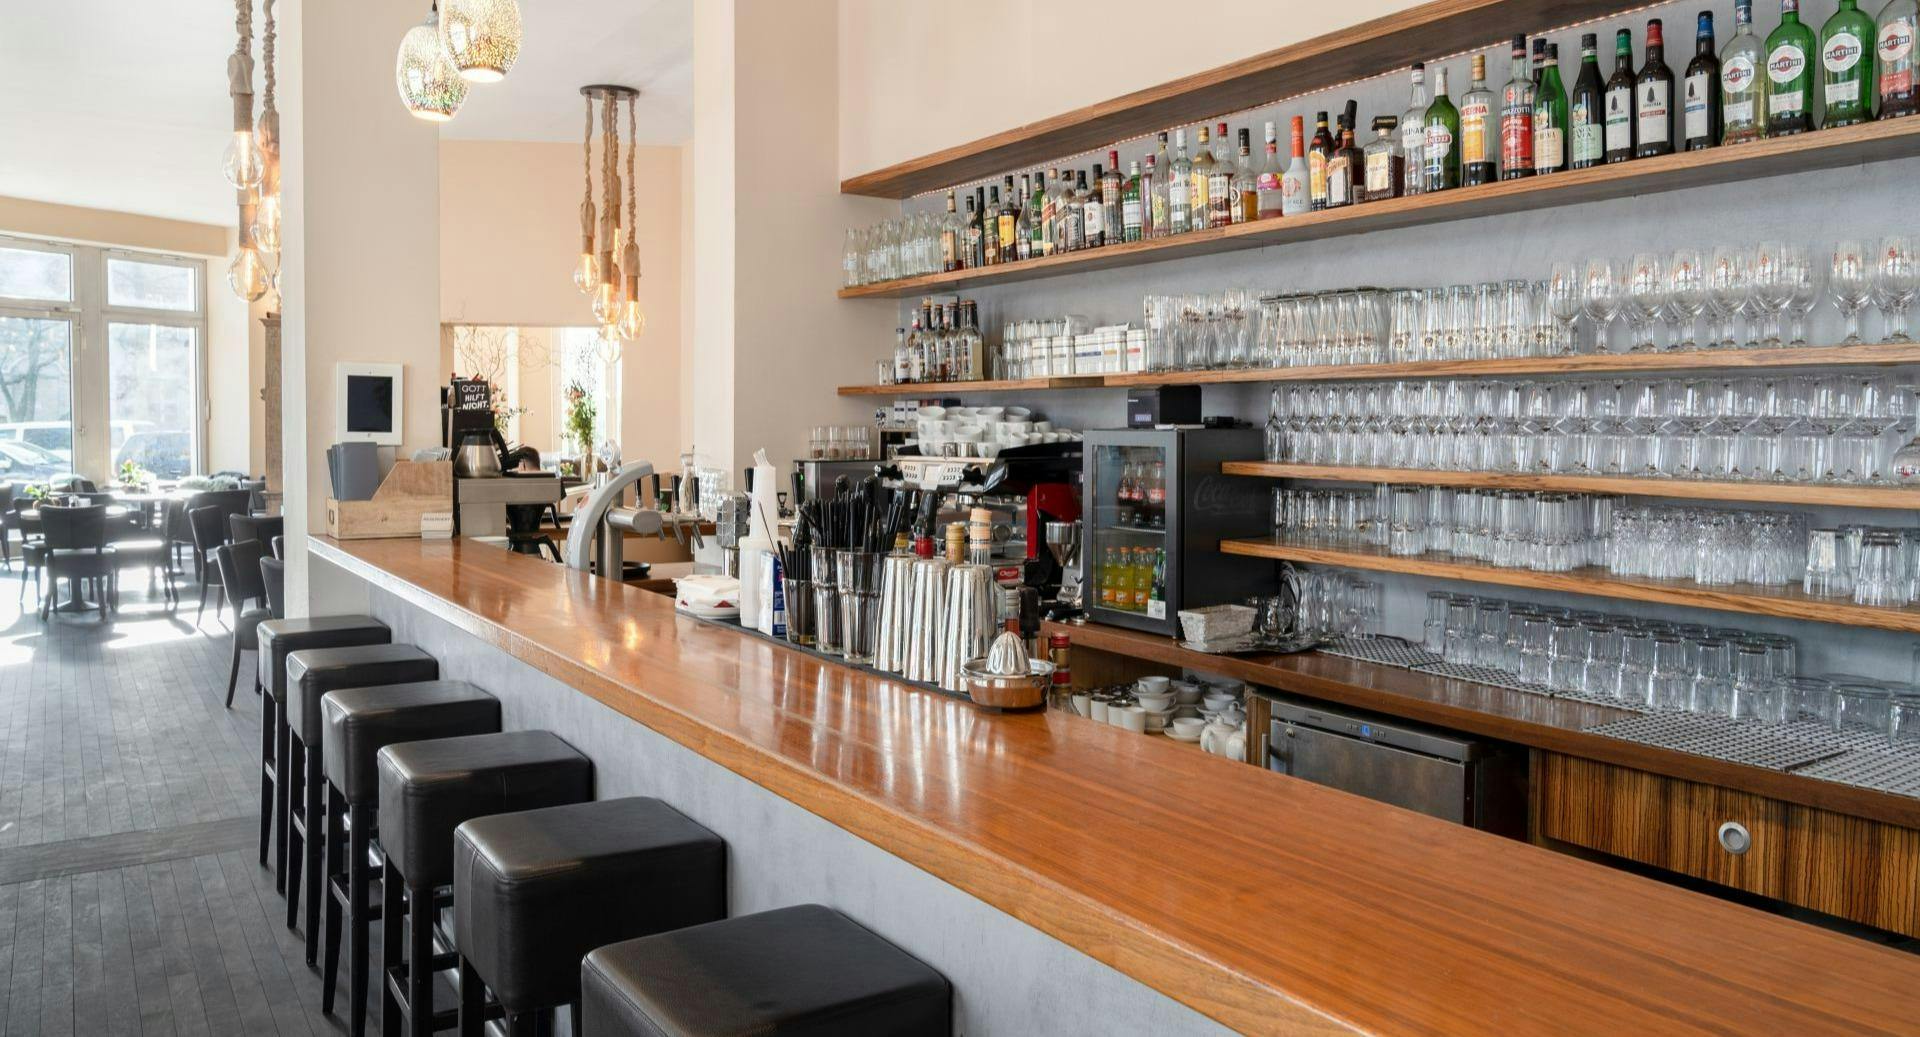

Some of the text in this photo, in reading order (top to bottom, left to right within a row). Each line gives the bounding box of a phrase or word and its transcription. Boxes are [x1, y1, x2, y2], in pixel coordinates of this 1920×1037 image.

[1879, 35, 1910, 51] MARTINI
[1825, 46, 1858, 60] MARTINI
[1769, 58, 1802, 71] MARTINI
[1723, 68, 1752, 81] MARTINI
[461, 384, 486, 393] GOTT
[465, 393, 485, 402] HILFT
